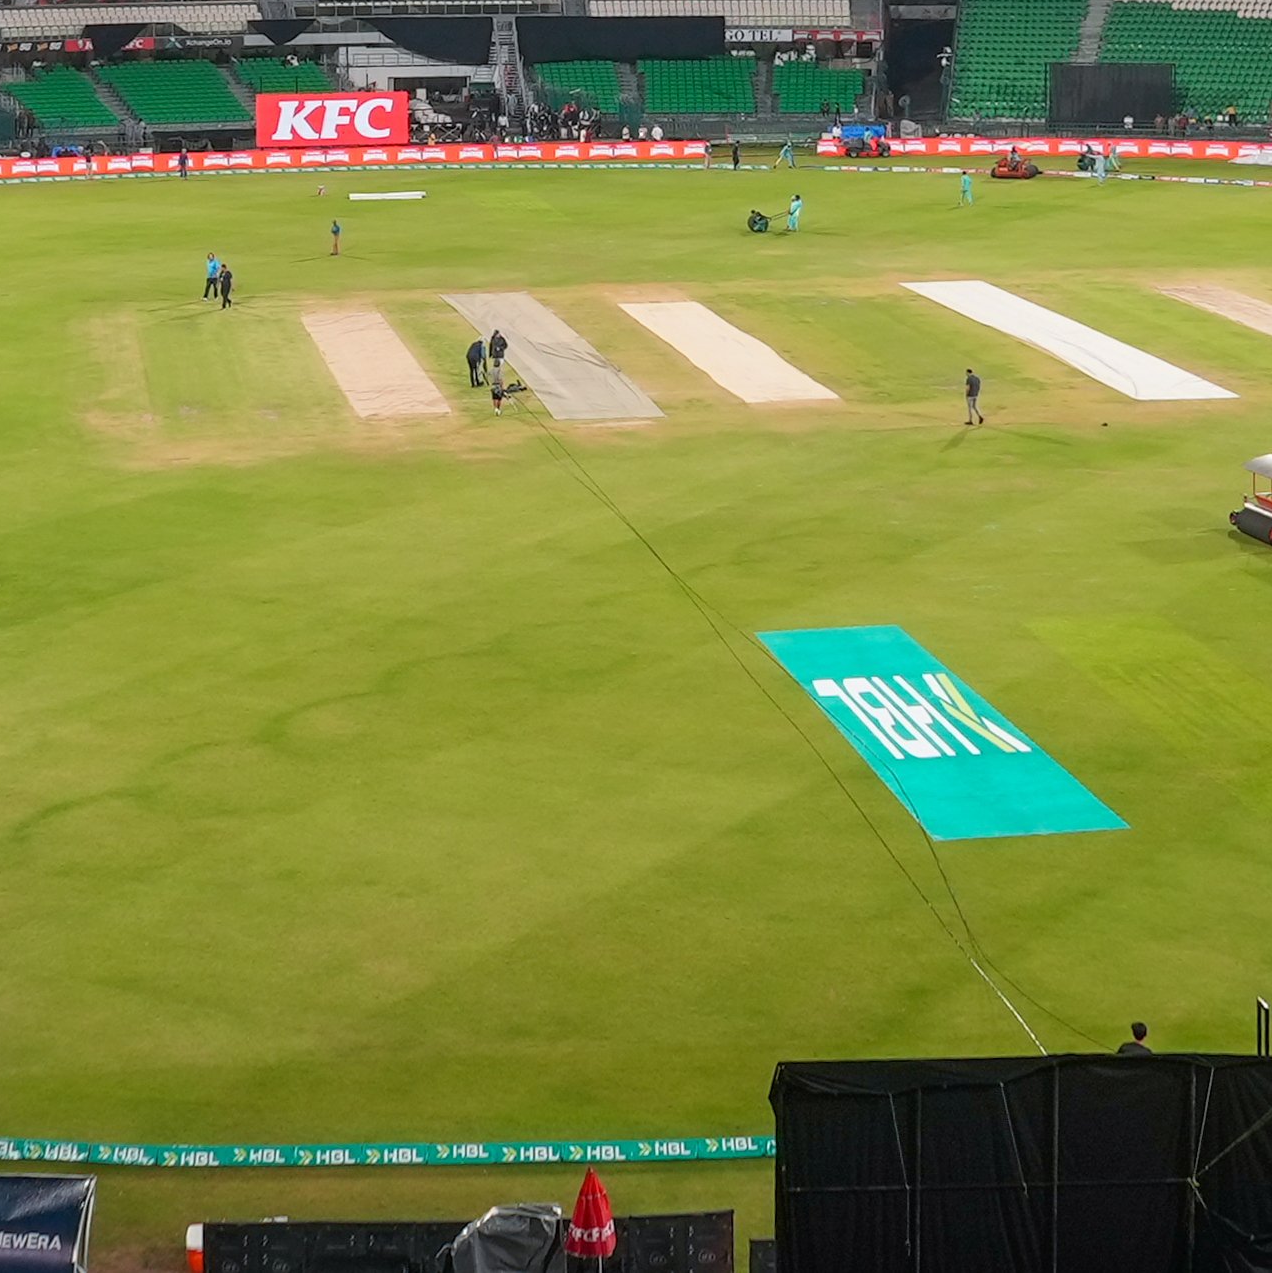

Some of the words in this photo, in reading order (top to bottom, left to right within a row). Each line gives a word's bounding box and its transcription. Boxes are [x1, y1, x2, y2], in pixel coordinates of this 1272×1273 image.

[747, 30, 779, 41] TEL
[271, 97, 393, 141] KFC
[45, 1143, 85, 1162] HBL
[113, 1147, 154, 1165] HBL
[180, 1151, 220, 1166] HBL
[249, 1148, 285, 1164] HBL
[316, 1149, 356, 1165] HBL
[383, 1148, 424, 1163] HBL
[452, 1144, 489, 1159] HBL
[519, 1146, 560, 1161] HBL
[586, 1146, 626, 1161] HBL
[654, 1141, 691, 1157] HBL
[722, 1136, 758, 1153] HBL
